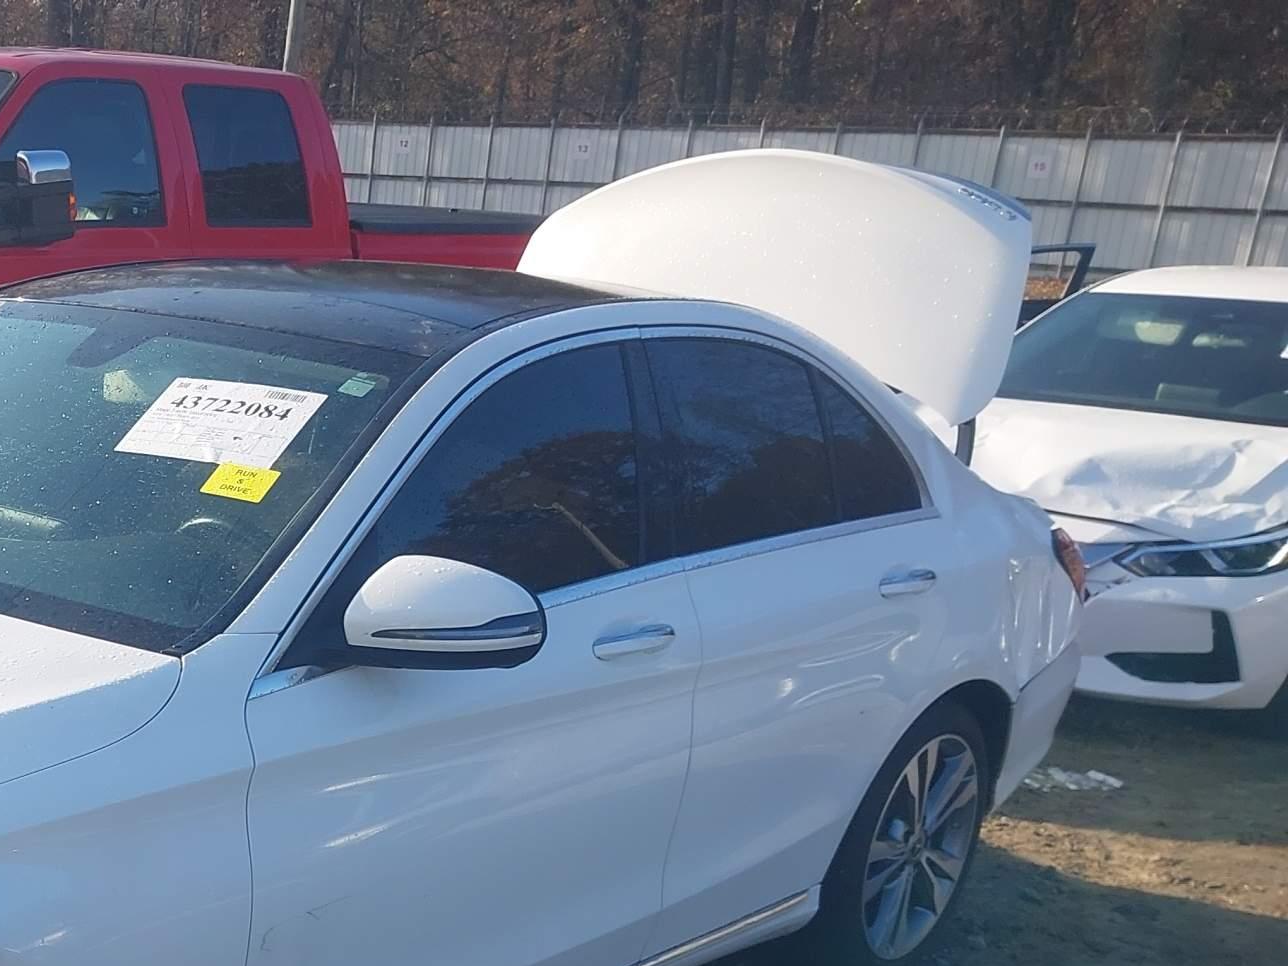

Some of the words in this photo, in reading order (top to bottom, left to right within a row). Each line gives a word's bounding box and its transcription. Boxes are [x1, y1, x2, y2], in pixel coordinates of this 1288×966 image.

[170, 394, 293, 421] 43722084
[235, 469, 258, 478] RUN
[219, 483, 253, 496] DRIVE
